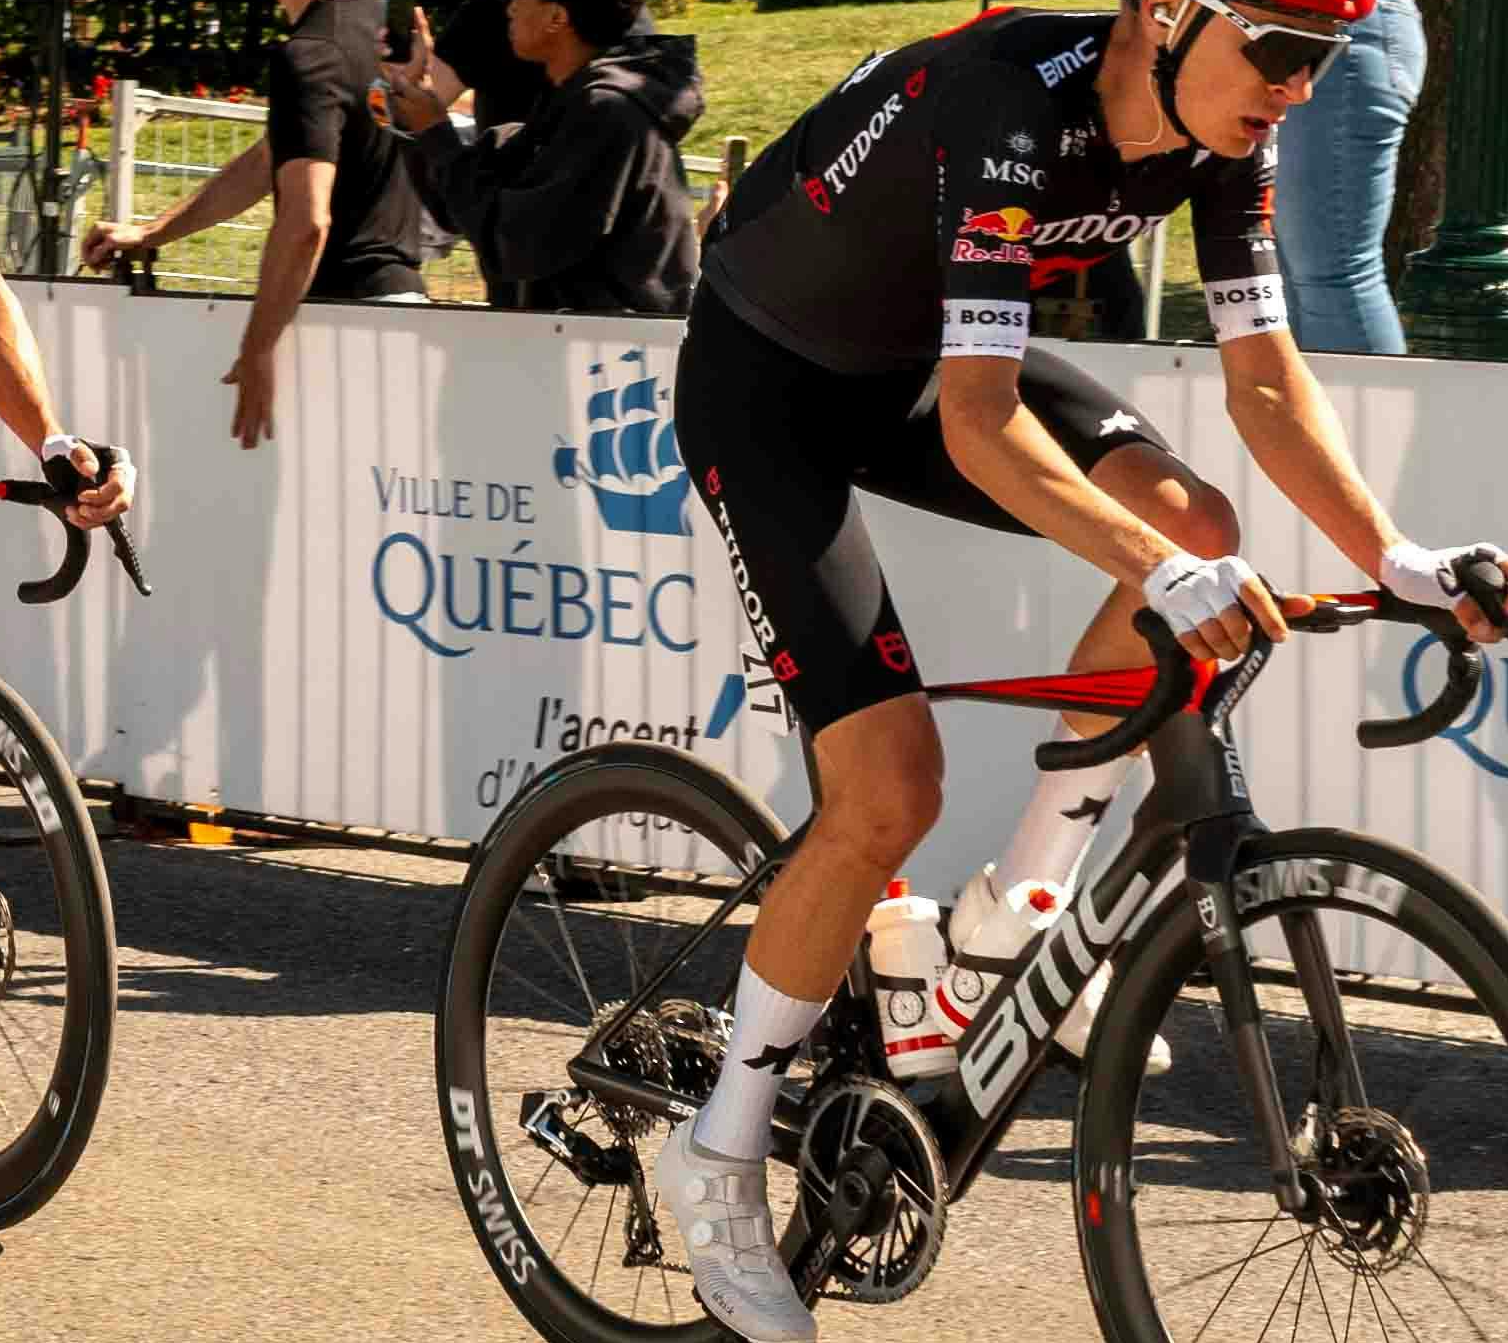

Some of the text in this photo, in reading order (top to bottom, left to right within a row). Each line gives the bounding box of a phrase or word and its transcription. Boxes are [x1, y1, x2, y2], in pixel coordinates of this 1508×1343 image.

[1037, 36, 1098, 88] BMC
[823, 93, 904, 195] TUDOR
[982, 157, 1047, 191] MSC
[960, 308, 1024, 327] BOSS
[1213, 284, 1274, 306] BOSS
[487, 483, 536, 524] DE
[372, 531, 700, 658] QUÉBEC
[719, 501, 776, 654] TUDOR
[742, 652, 783, 716] 217
[960, 868, 1152, 1119] BMC
[447, 1085, 540, 1290] DT SWISS
